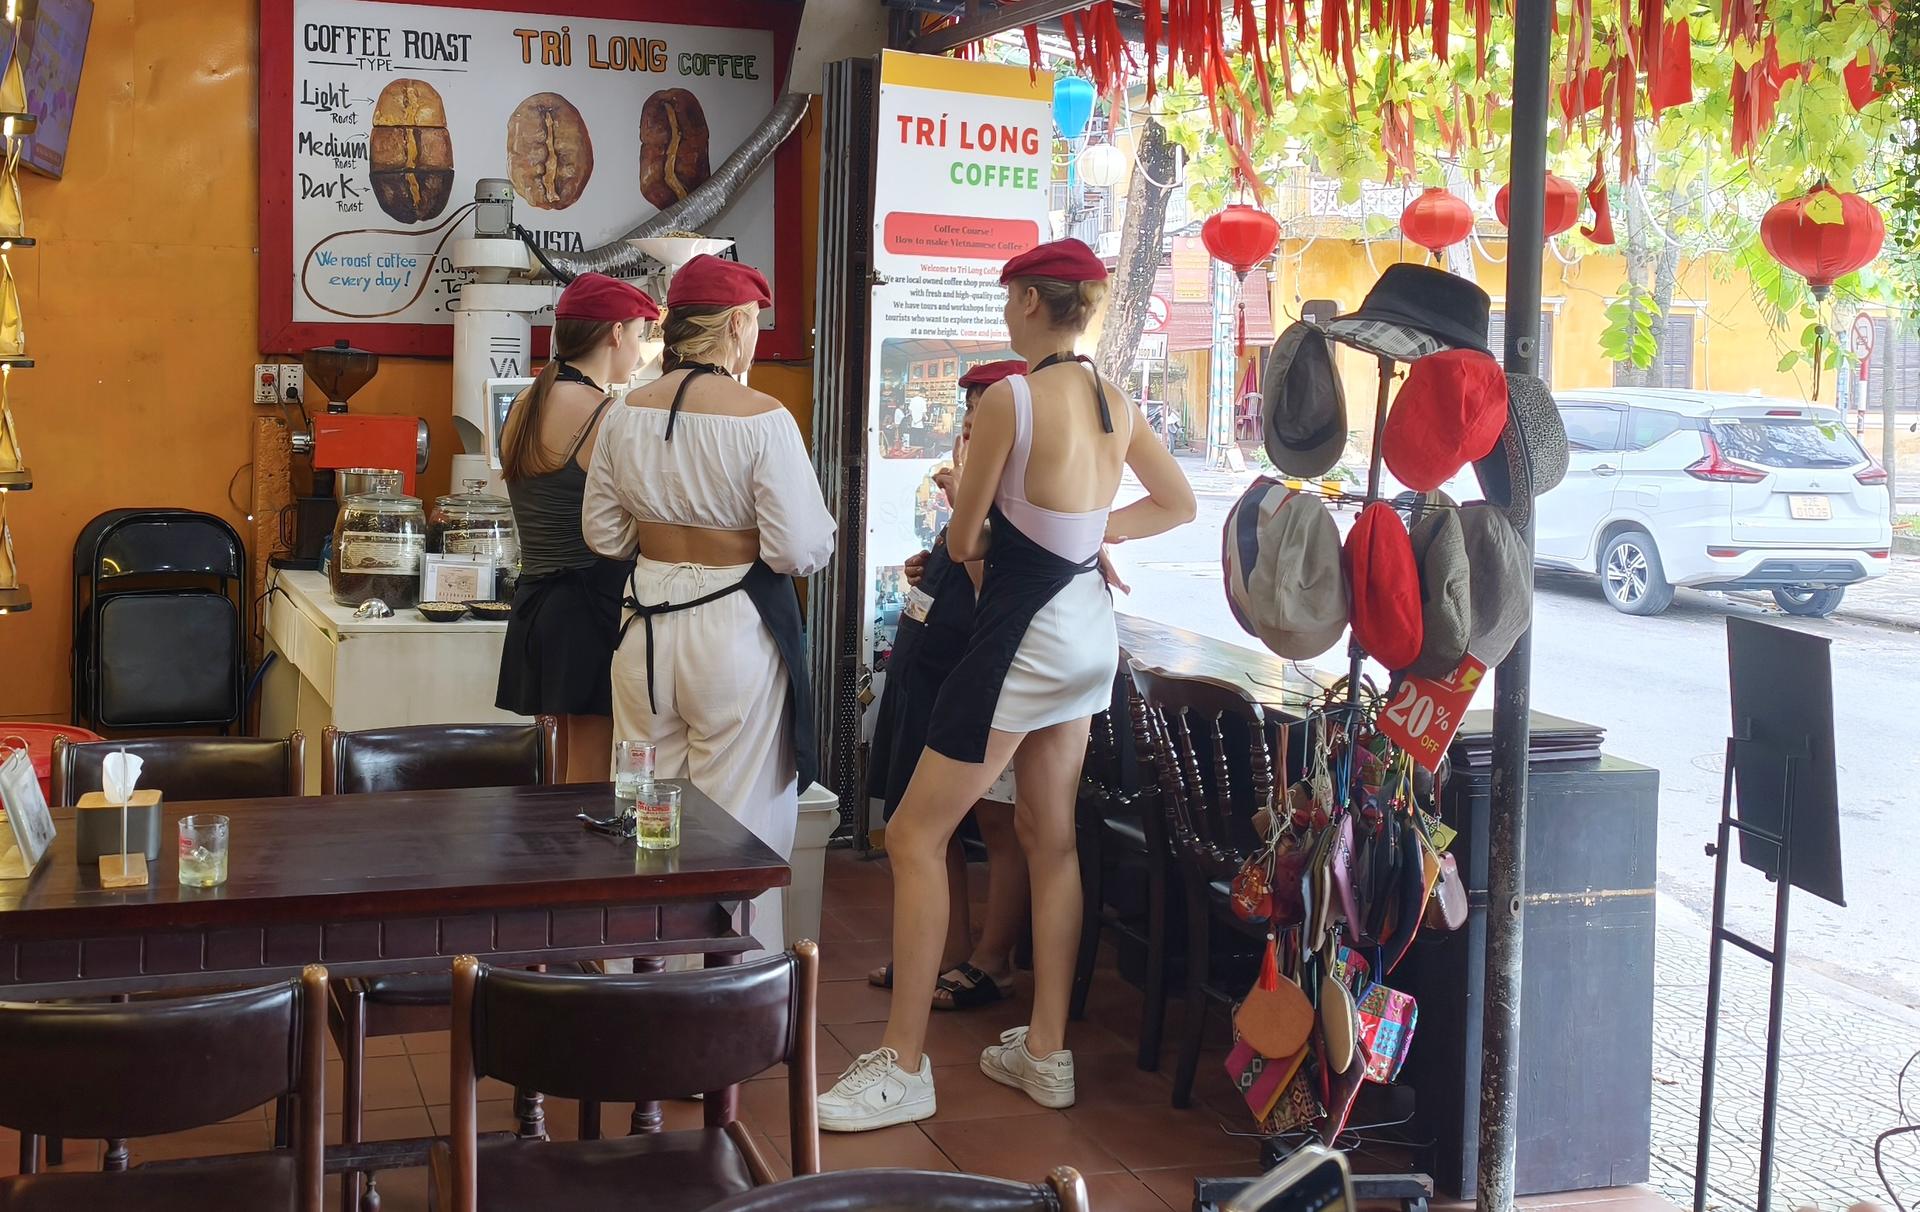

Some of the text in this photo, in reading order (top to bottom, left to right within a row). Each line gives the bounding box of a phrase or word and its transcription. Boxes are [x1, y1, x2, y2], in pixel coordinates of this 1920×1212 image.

[304, 23, 472, 62] COFFEE ROAST
[355, 57, 393, 72] TYPE
[588, 34, 668, 73] LONG
[678, 52, 759, 80] COFFEE
[300, 79, 352, 112] Light
[330, 111, 359, 125] Roast
[896, 112, 1039, 156] TRÍ LONG
[298, 131, 368, 161] Medium
[332, 157, 357, 169] Roast
[950, 161, 1039, 190] COFFEE
[298, 172, 360, 200] Dark
[335, 200, 364, 212] Roast
[934, 224, 960, 234] Coffee
[895, 235, 913, 244] How
[916, 236, 924, 245] to
[926, 237, 948, 247] make
[950, 238, 996, 250] Vietnamese
[997, 241, 1023, 250] Coffee
[315, 251, 417, 269] We roast coffee
[920, 263, 949, 273] Welcome
[950, 265, 957, 273] to
[968, 266, 982, 276] Long
[328, 274, 371, 293] every
[884, 274, 894, 283] We
[895, 276, 905, 284] are
[906, 275, 922, 285] local
[922, 277, 943, 285] owned
[944, 277, 962, 286] coffee
[963, 278, 978, 288] shop
[910, 289, 925, 297] with
[925, 289, 942, 298] fresh
[943, 290, 955, 298] and
[893, 301, 904, 309] We
[905, 301, 920, 310] have
[920, 302, 937, 310] tours
[938, 302, 950, 311] and
[950, 303, 984, 313] workshops
[984, 304, 994, 312] for
[885, 313, 911, 321] tourists
[911, 313, 925, 322] who
[926, 315, 942, 323] want
[942, 315, 949, 323] to
[950, 316, 973, 325] explore
[974, 316, 983, 325] the
[984, 316, 999, 325] local
[910, 327, 917, 335] at
[923, 328, 936, 336] new
[979, 328, 989, 337] and
[1420, 735, 1440, 753] OFF
